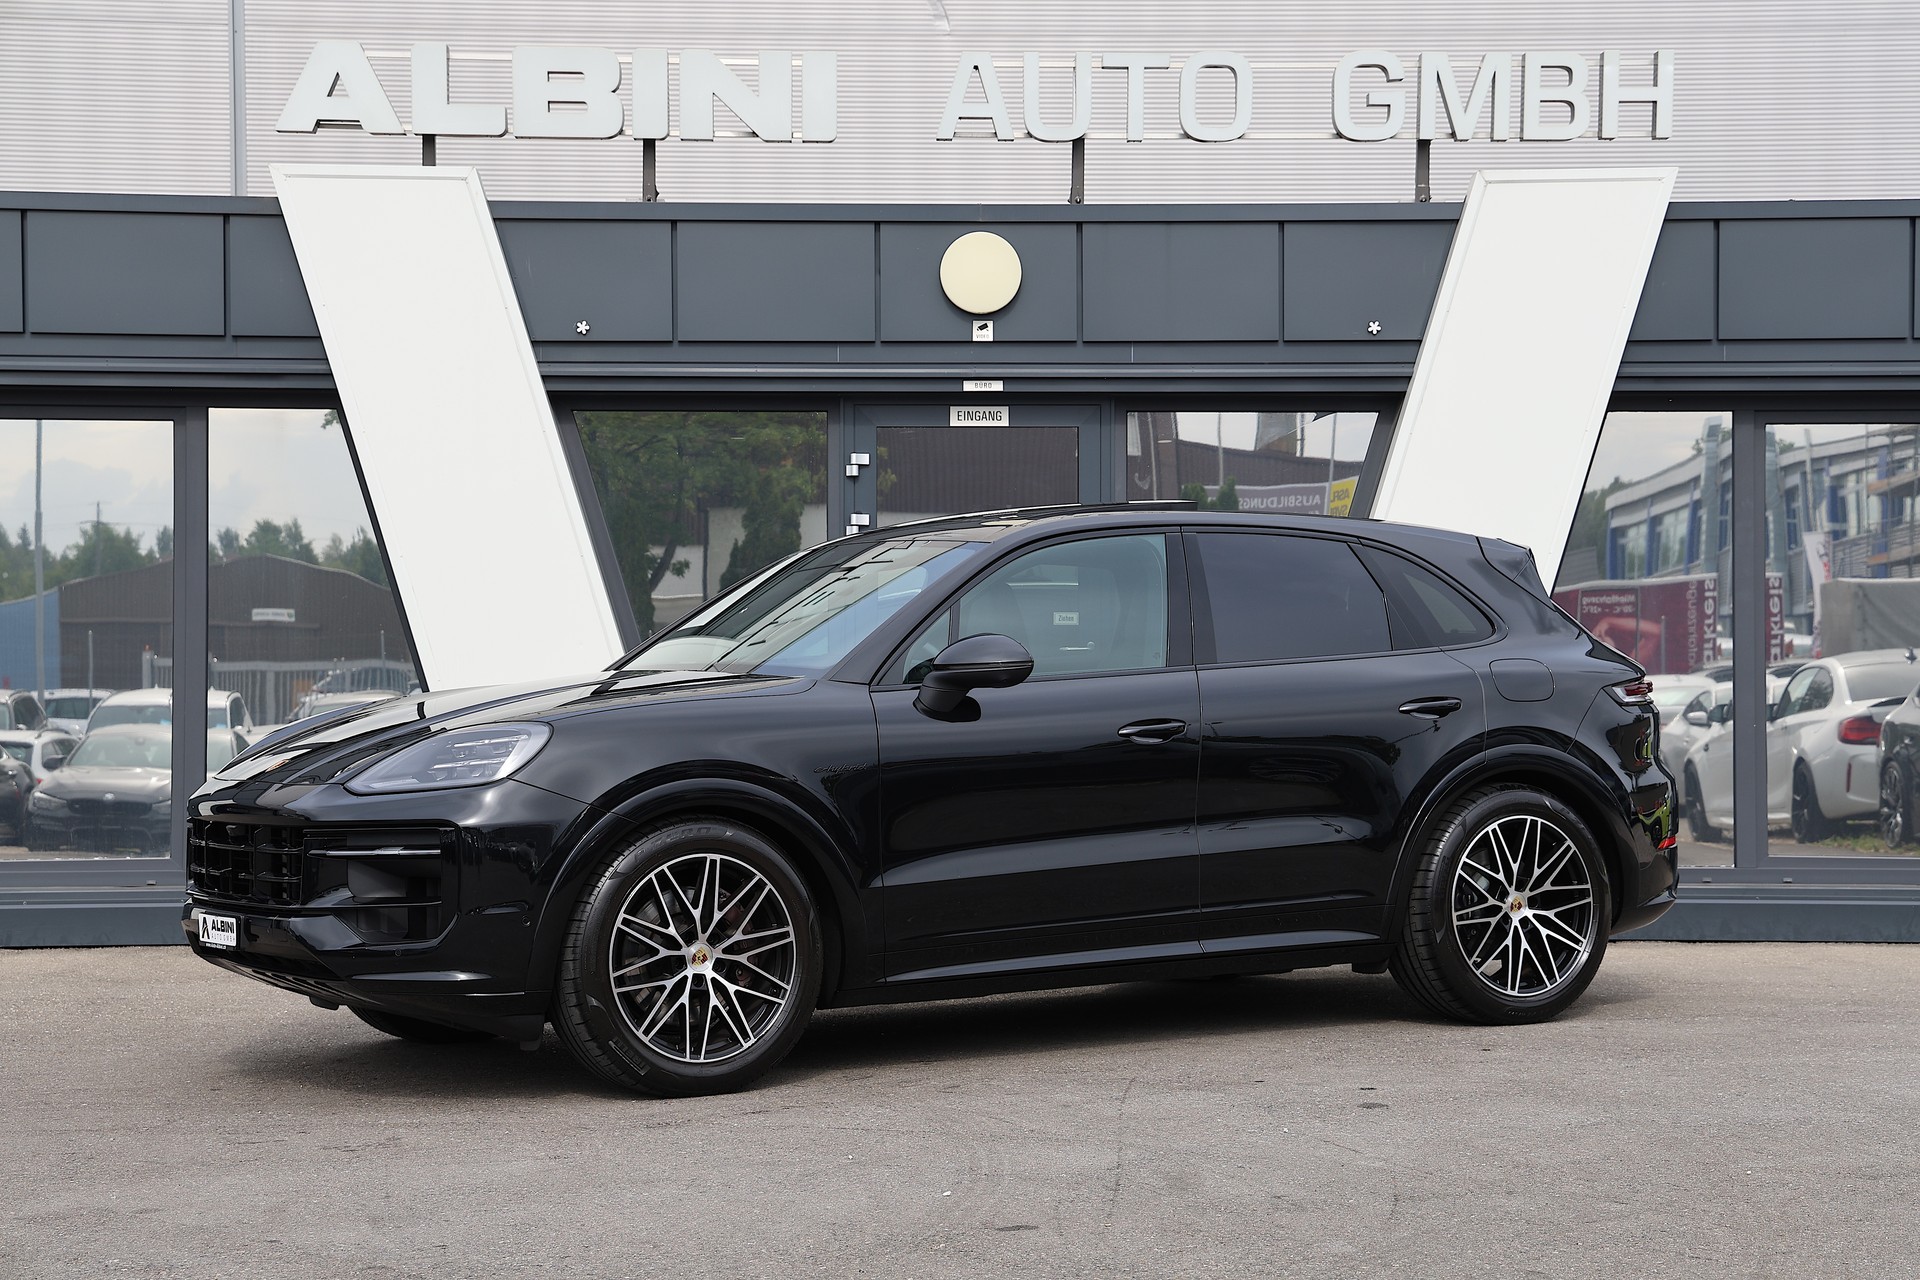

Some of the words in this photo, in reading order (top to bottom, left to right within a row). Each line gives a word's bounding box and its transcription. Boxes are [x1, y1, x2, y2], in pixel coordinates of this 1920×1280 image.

[276, 41, 838, 143] ALBINI
[936, 50, 1254, 143] AUTO
[1331, 49, 1675, 142] GMBH
[974, 381, 993, 389] BÜRO
[957, 410, 1003, 422] EINGANG
[211, 918, 235, 934] ALBINI
